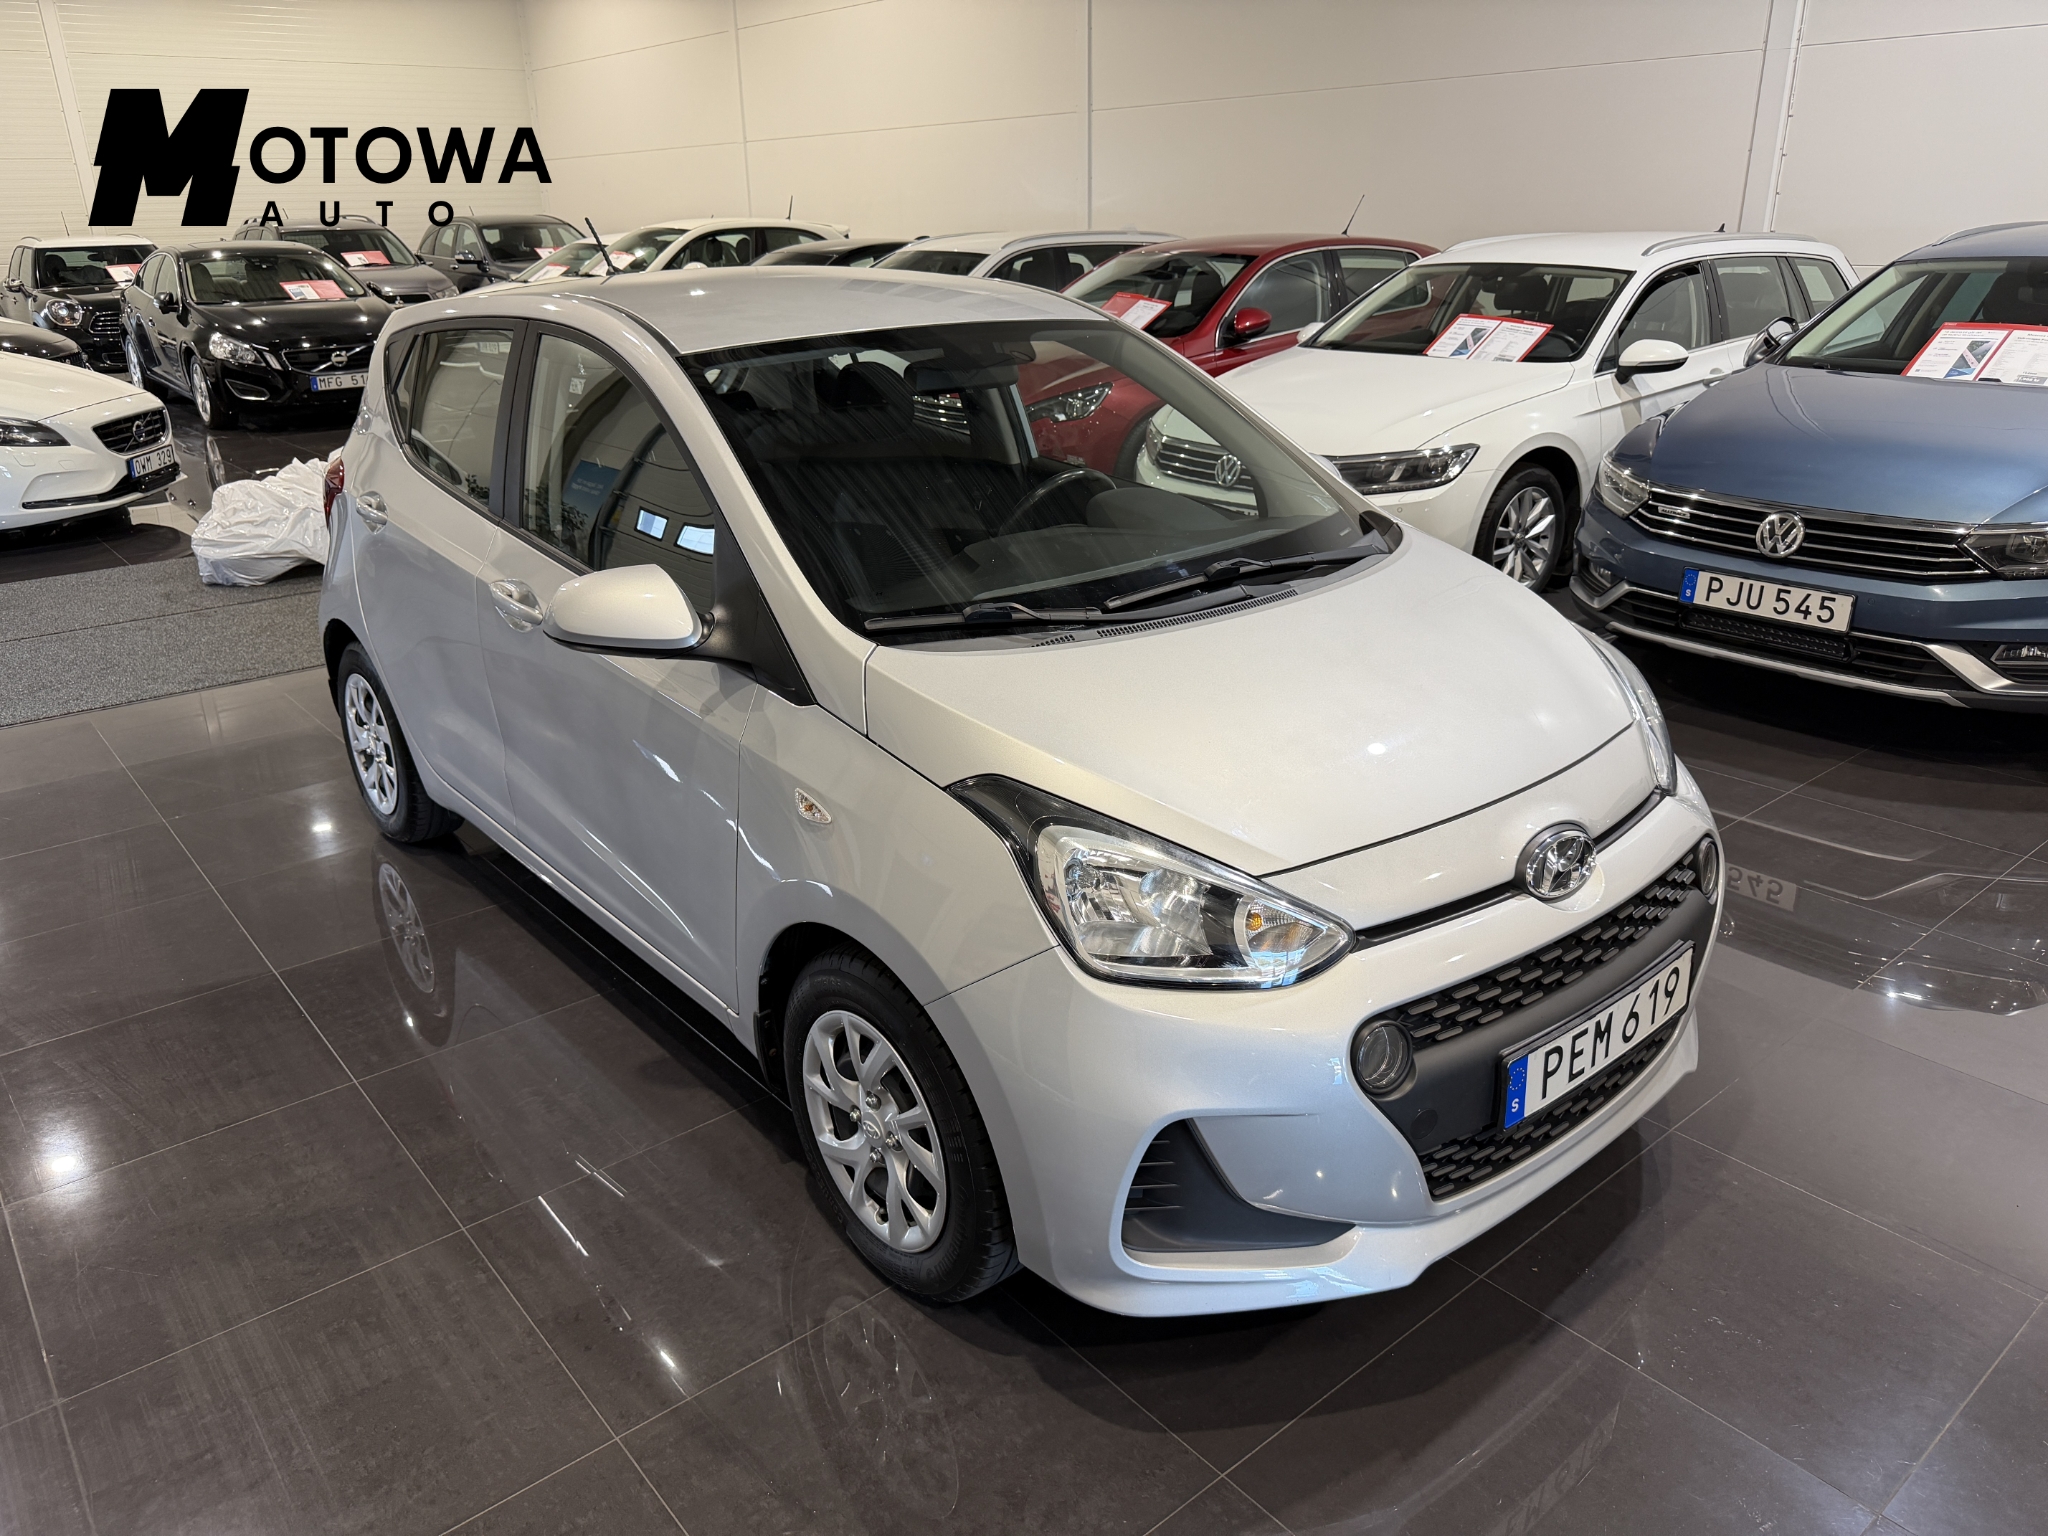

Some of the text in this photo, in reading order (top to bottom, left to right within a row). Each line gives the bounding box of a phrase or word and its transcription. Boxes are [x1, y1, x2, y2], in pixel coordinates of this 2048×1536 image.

[319, 374, 368, 388] MFG 51
[135, 449, 172, 475] OWM 329
[1685, 576, 1837, 624] S PJU 545
[1511, 966, 1681, 1113] S PEM 619
